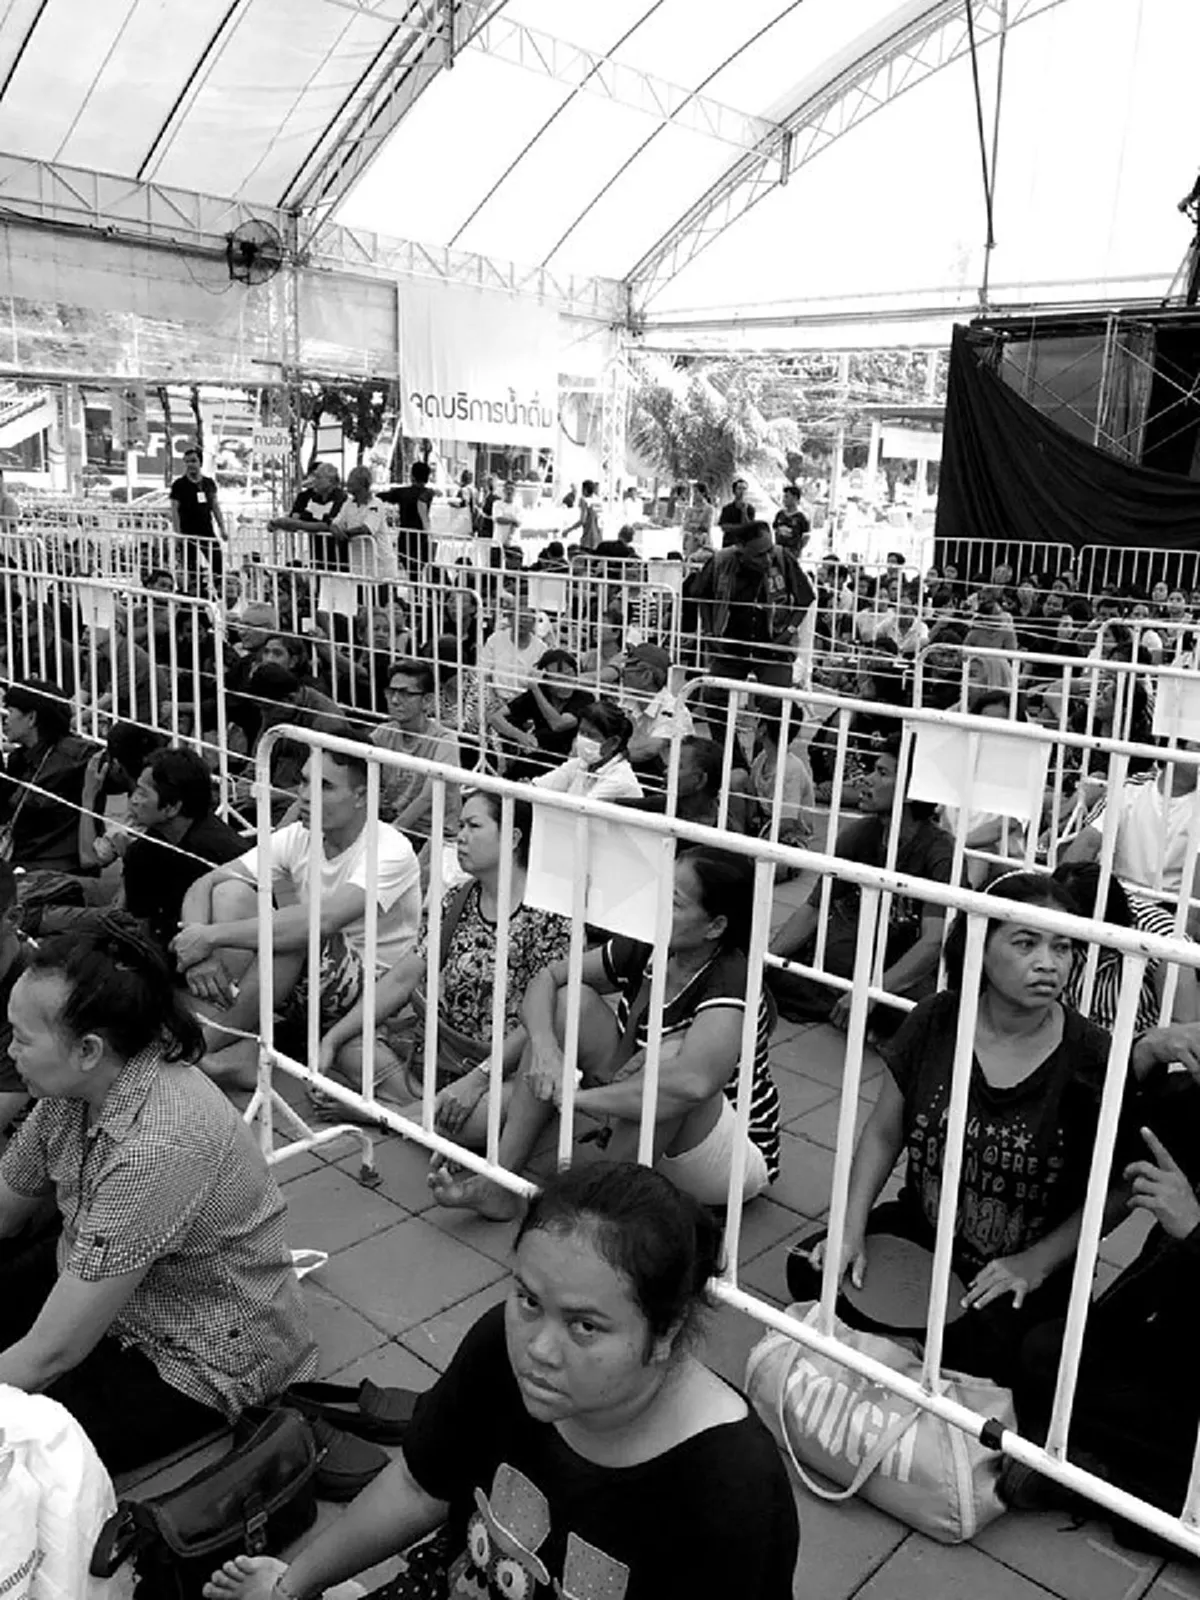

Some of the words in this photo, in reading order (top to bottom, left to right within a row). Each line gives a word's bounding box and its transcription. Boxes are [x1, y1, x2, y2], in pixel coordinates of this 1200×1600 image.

[409, 387, 552, 428] จุดบริการน้ำดื่ม
